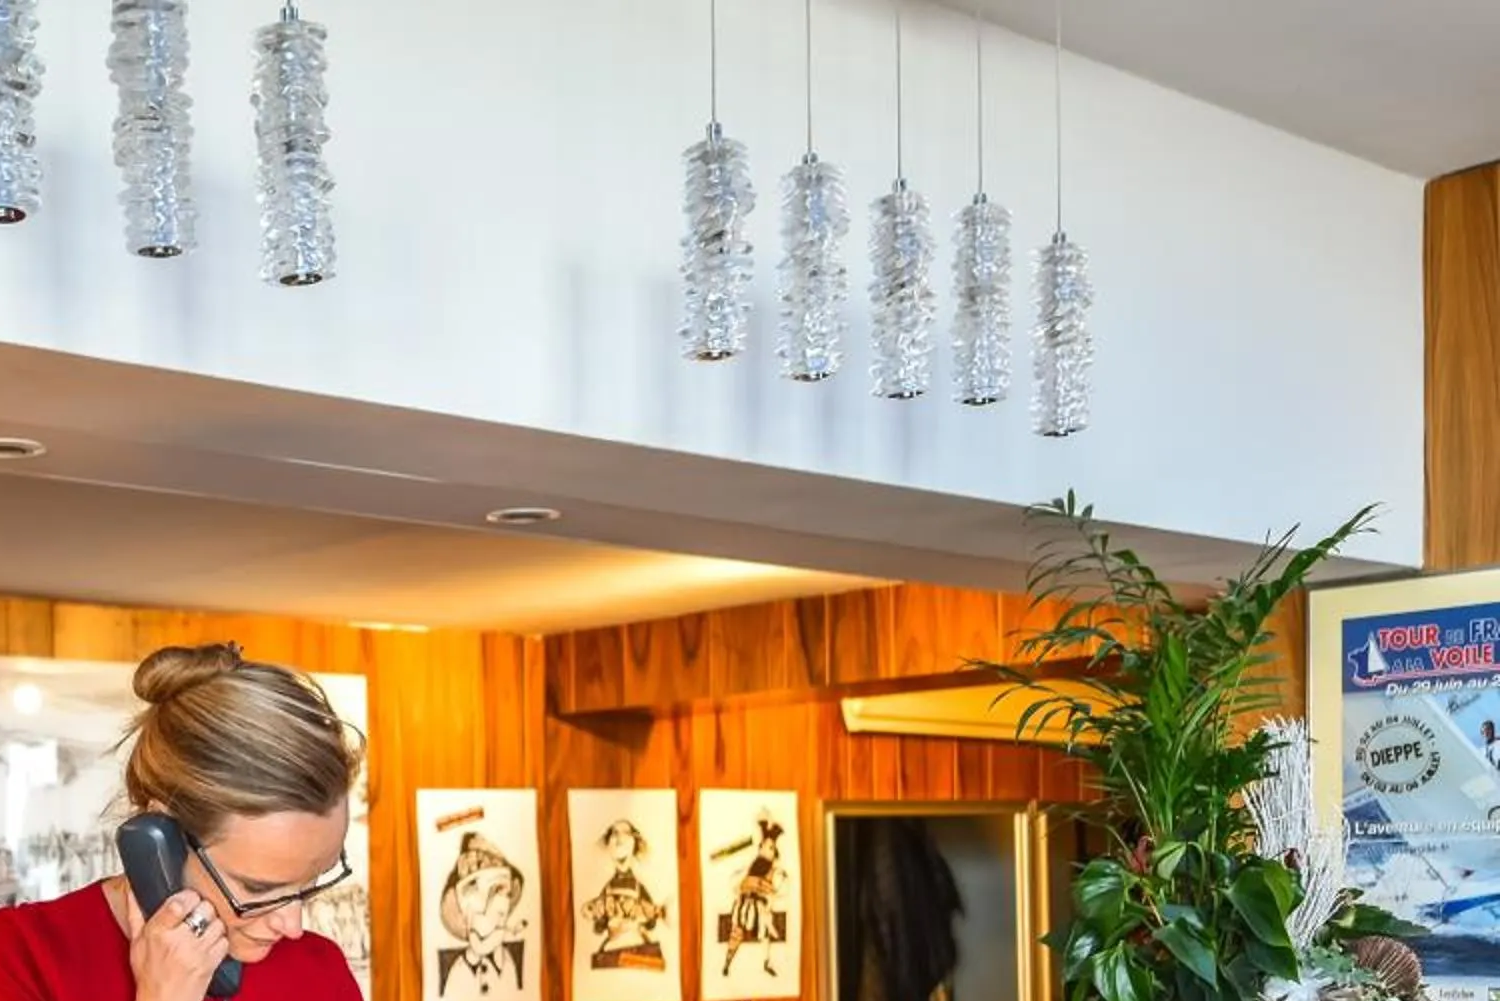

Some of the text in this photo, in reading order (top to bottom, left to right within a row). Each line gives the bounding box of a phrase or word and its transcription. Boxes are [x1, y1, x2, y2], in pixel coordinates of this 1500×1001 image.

[1377, 623, 1441, 653] TOUR
[1429, 642, 1495, 670] VOILE
[1385, 682, 1408, 698] Du
[1411, 680, 1431, 694] 29
[1432, 678, 1463, 695] juin
[1466, 677, 1488, 689] au
[1370, 740, 1424, 768] DIEPPE
